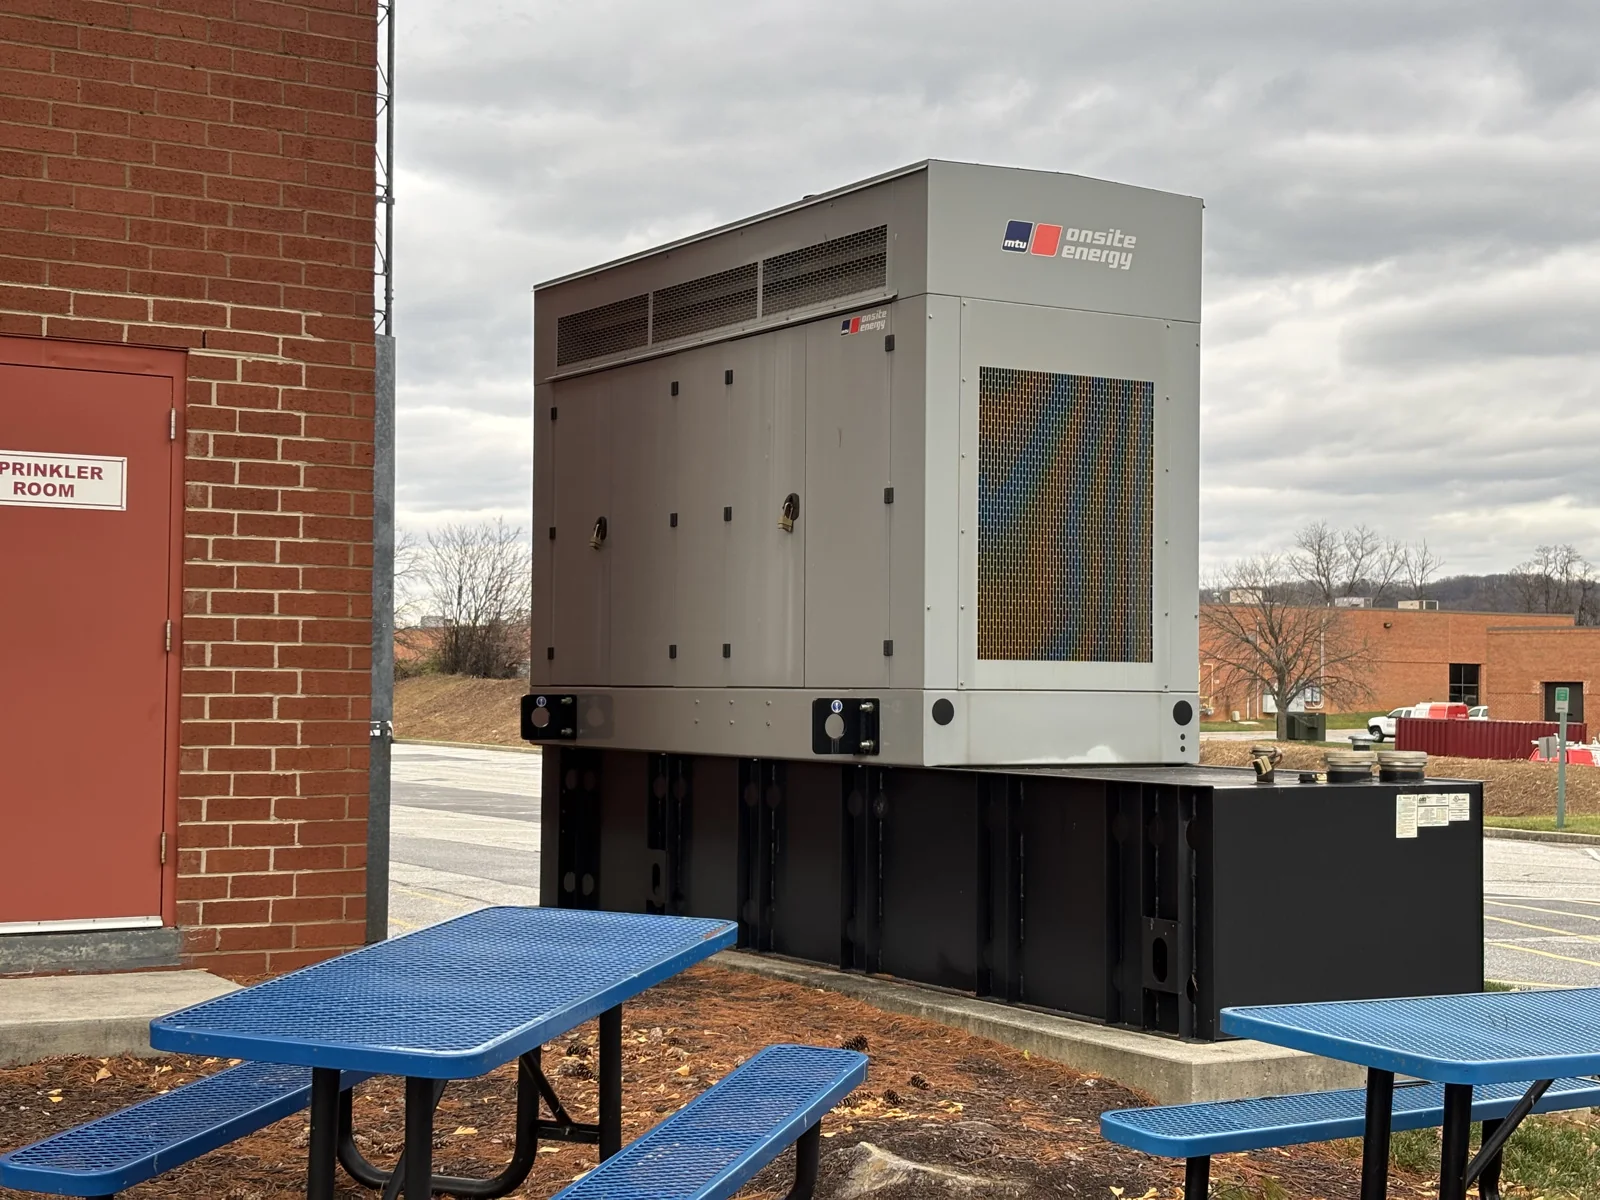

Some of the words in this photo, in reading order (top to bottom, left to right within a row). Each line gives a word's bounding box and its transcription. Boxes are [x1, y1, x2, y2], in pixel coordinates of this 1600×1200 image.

[1004, 240, 1027, 249] mtu
[1066, 228, 1136, 249] onsite
[1061, 245, 1133, 270] energy
[861, 310, 887, 322] onsite
[860, 320, 886, 331] energy
[13, 482, 75, 498] ROOM
